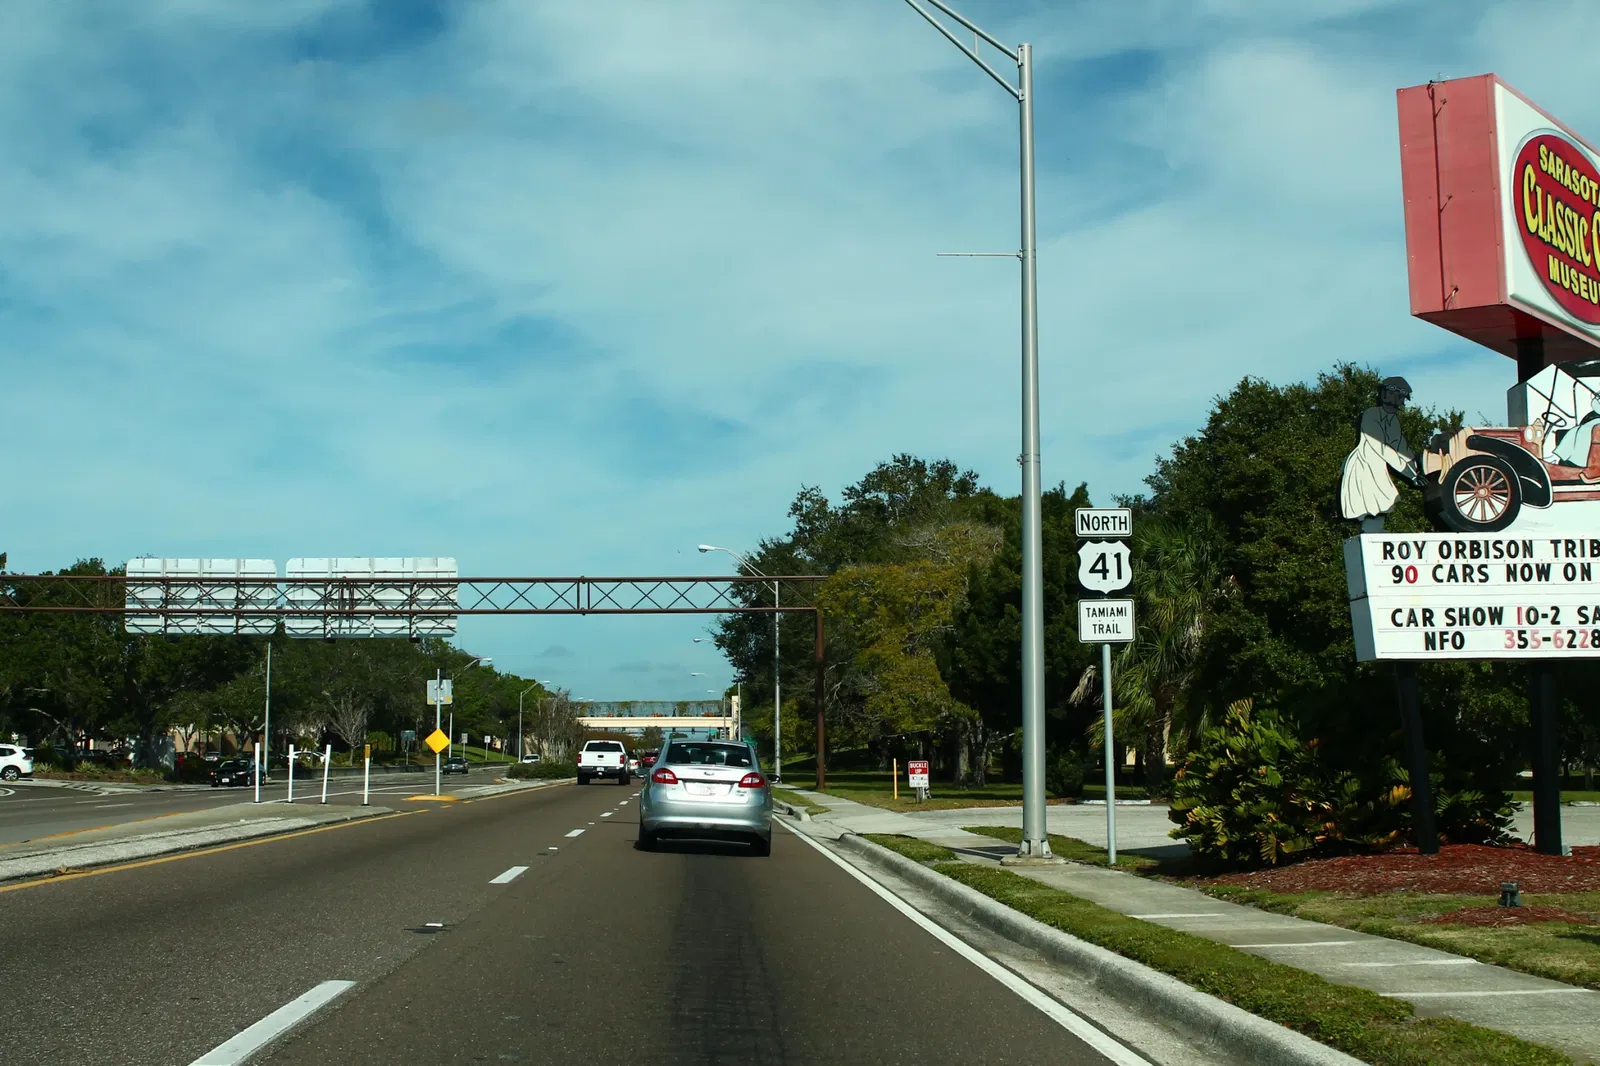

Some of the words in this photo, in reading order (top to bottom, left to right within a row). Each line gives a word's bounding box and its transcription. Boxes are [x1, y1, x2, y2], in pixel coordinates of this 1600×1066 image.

[1539, 144, 1600, 208] SARASOT
[1524, 164, 1591, 267] CLASSIC
[1549, 255, 1600, 305] MUSEU
[1080, 514, 1127, 531] NORTH
[1382, 541, 1426, 560] ROY
[1438, 540, 1533, 559] ORBISON
[1550, 539, 1600, 558] TRIB
[1089, 552, 1122, 580] 41
[1392, 564, 1418, 584] 90
[1432, 564, 1489, 583] CARS
[1506, 563, 1551, 582] NOW
[1563, 562, 1592, 581] ON
[1086, 606, 1127, 618] TAMIAMI
[1391, 608, 1435, 627] CAR
[1444, 606, 1504, 626] SHOW
[1517, 605, 1560, 625] 10-2
[1092, 624, 1121, 634] TRAIL
[1424, 631, 1465, 650] NFO
[1504, 629, 1600, 650] 355-6228
